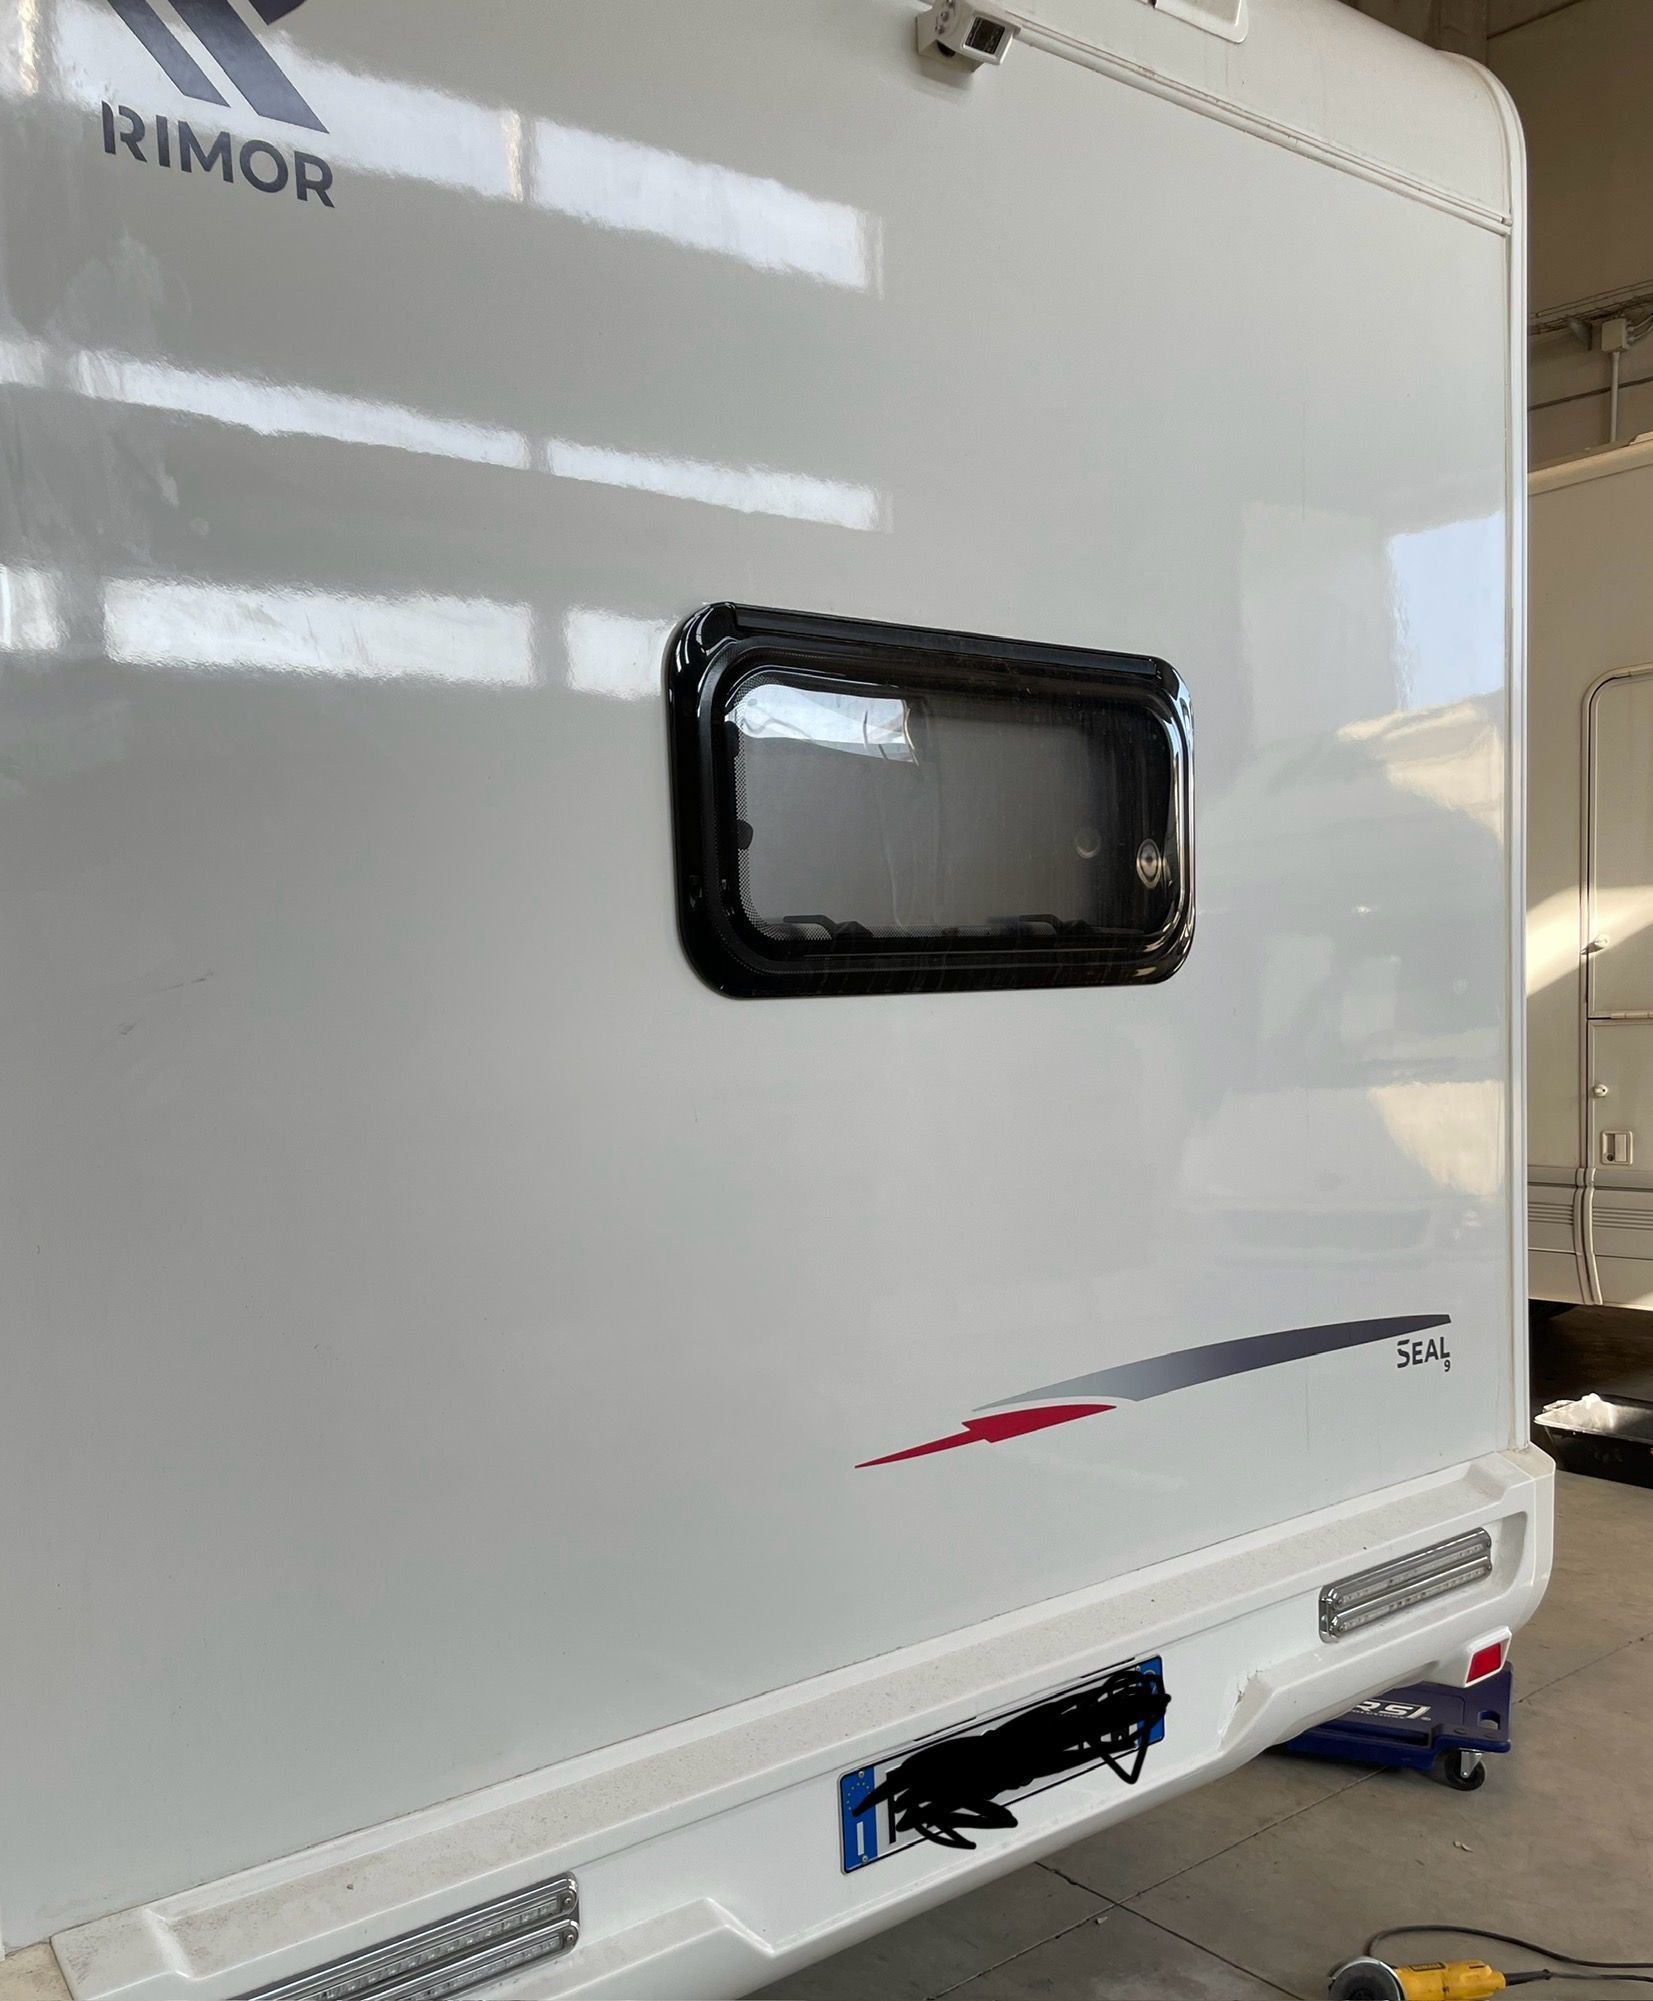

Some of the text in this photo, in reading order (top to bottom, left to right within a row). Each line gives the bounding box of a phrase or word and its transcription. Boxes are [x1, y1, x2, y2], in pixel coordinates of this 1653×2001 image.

[101, 100, 335, 208] RIMOR
[1397, 1336, 1451, 1369] SEAL
[1443, 1359, 1451, 1373] 9
